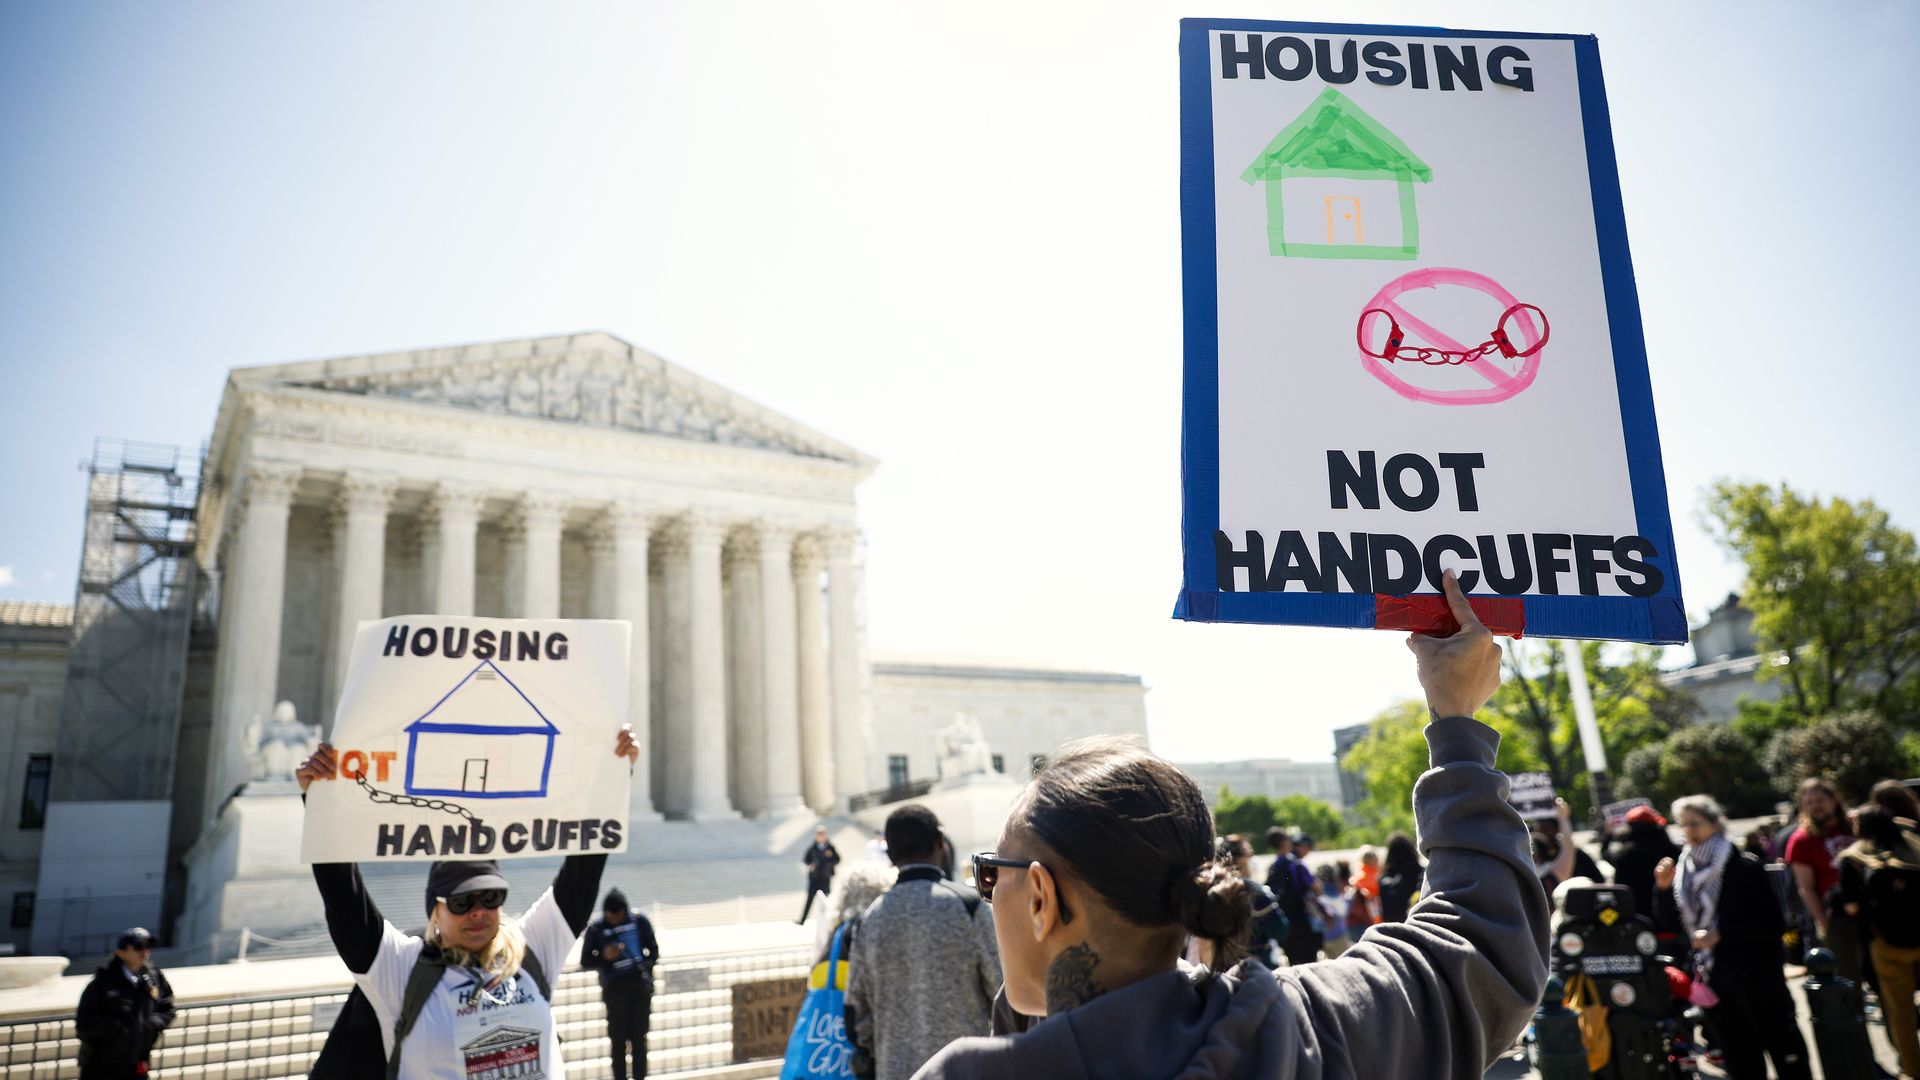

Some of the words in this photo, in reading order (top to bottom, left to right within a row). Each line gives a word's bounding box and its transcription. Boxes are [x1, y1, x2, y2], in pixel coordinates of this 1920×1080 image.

[1219, 33, 1535, 92] HOUSING
[1326, 450, 1485, 512] NOT
[1214, 530, 1664, 597] HANDCUFFS
[383, 625, 568, 661] HOUSING
[376, 819, 622, 856] HANDCUFFS
